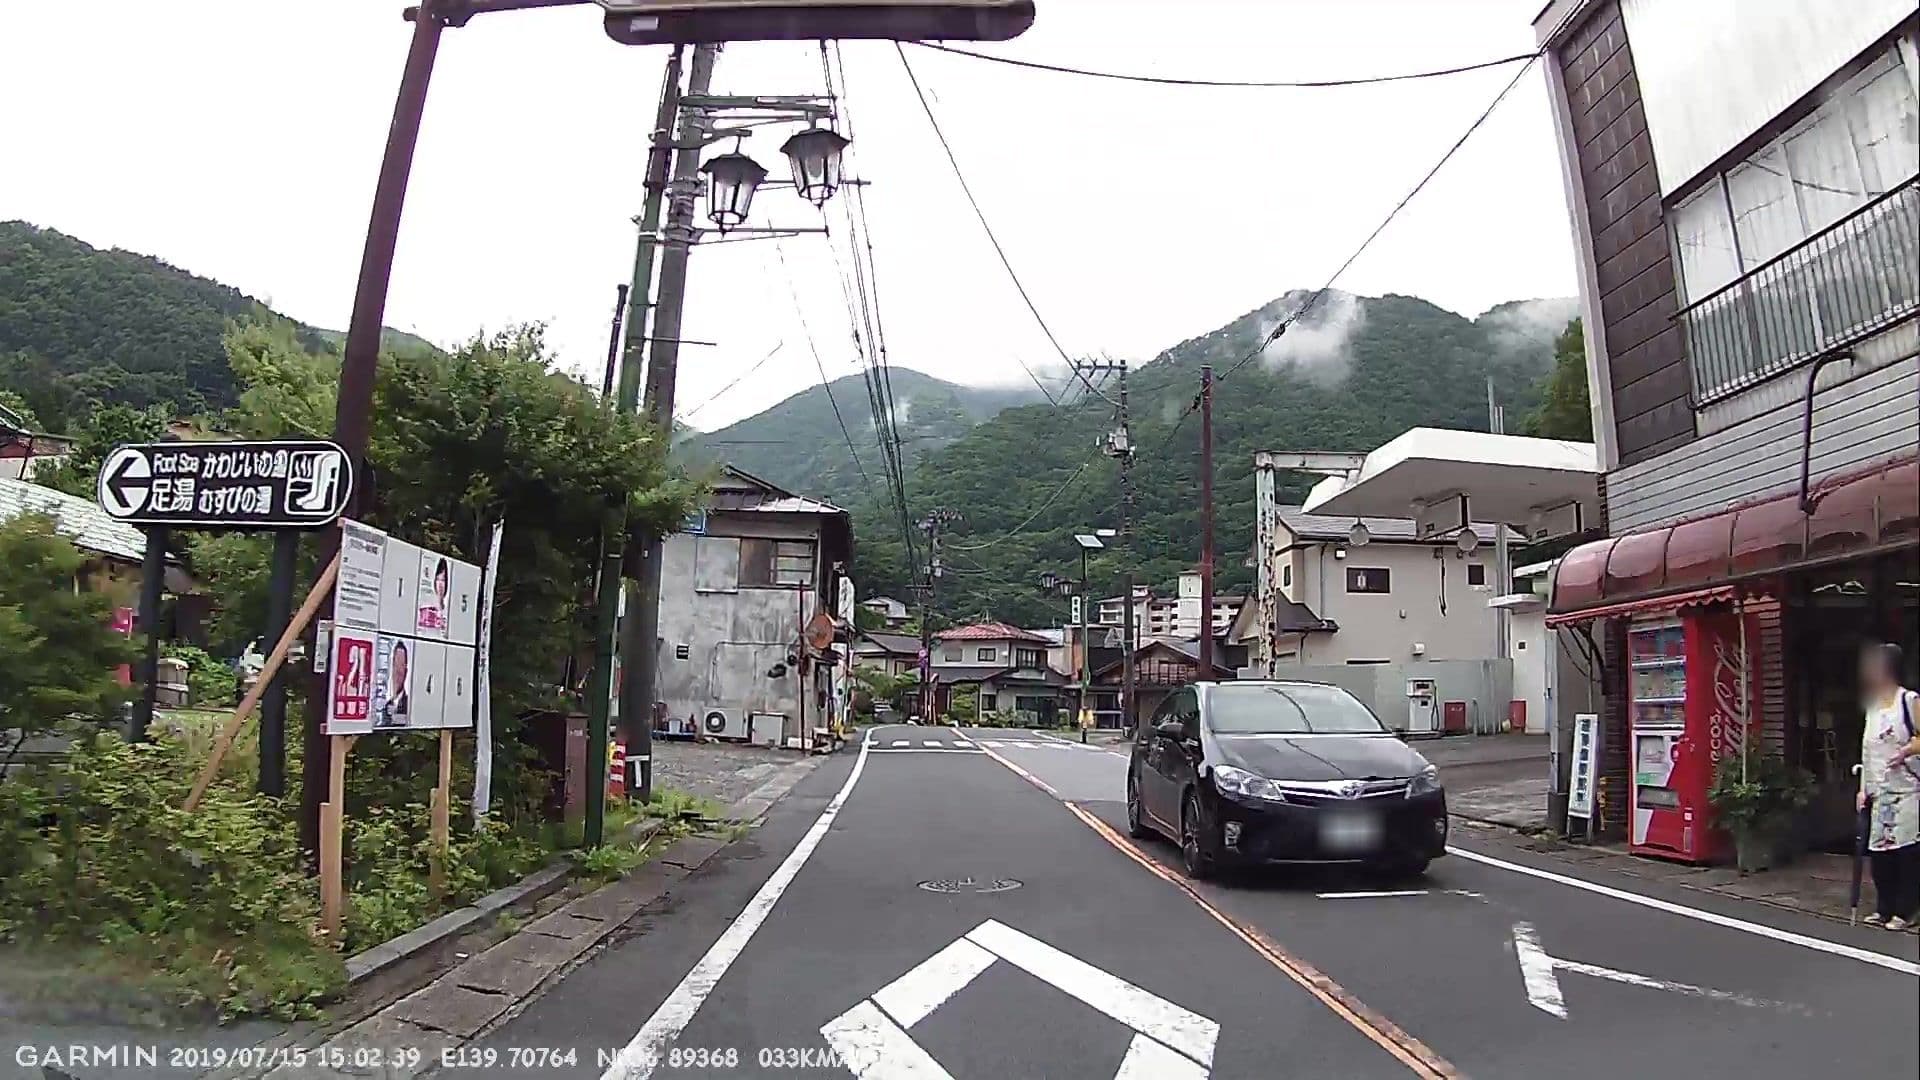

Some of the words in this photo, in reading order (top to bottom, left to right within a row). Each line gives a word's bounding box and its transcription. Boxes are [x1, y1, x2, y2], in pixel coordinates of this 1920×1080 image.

[147, 478, 196, 512] 足湯
[199, 485, 273, 515] むすびの湯
[461, 593, 468, 613] 5
[425, 673, 434, 695] 4
[456, 677, 463, 697] 6
